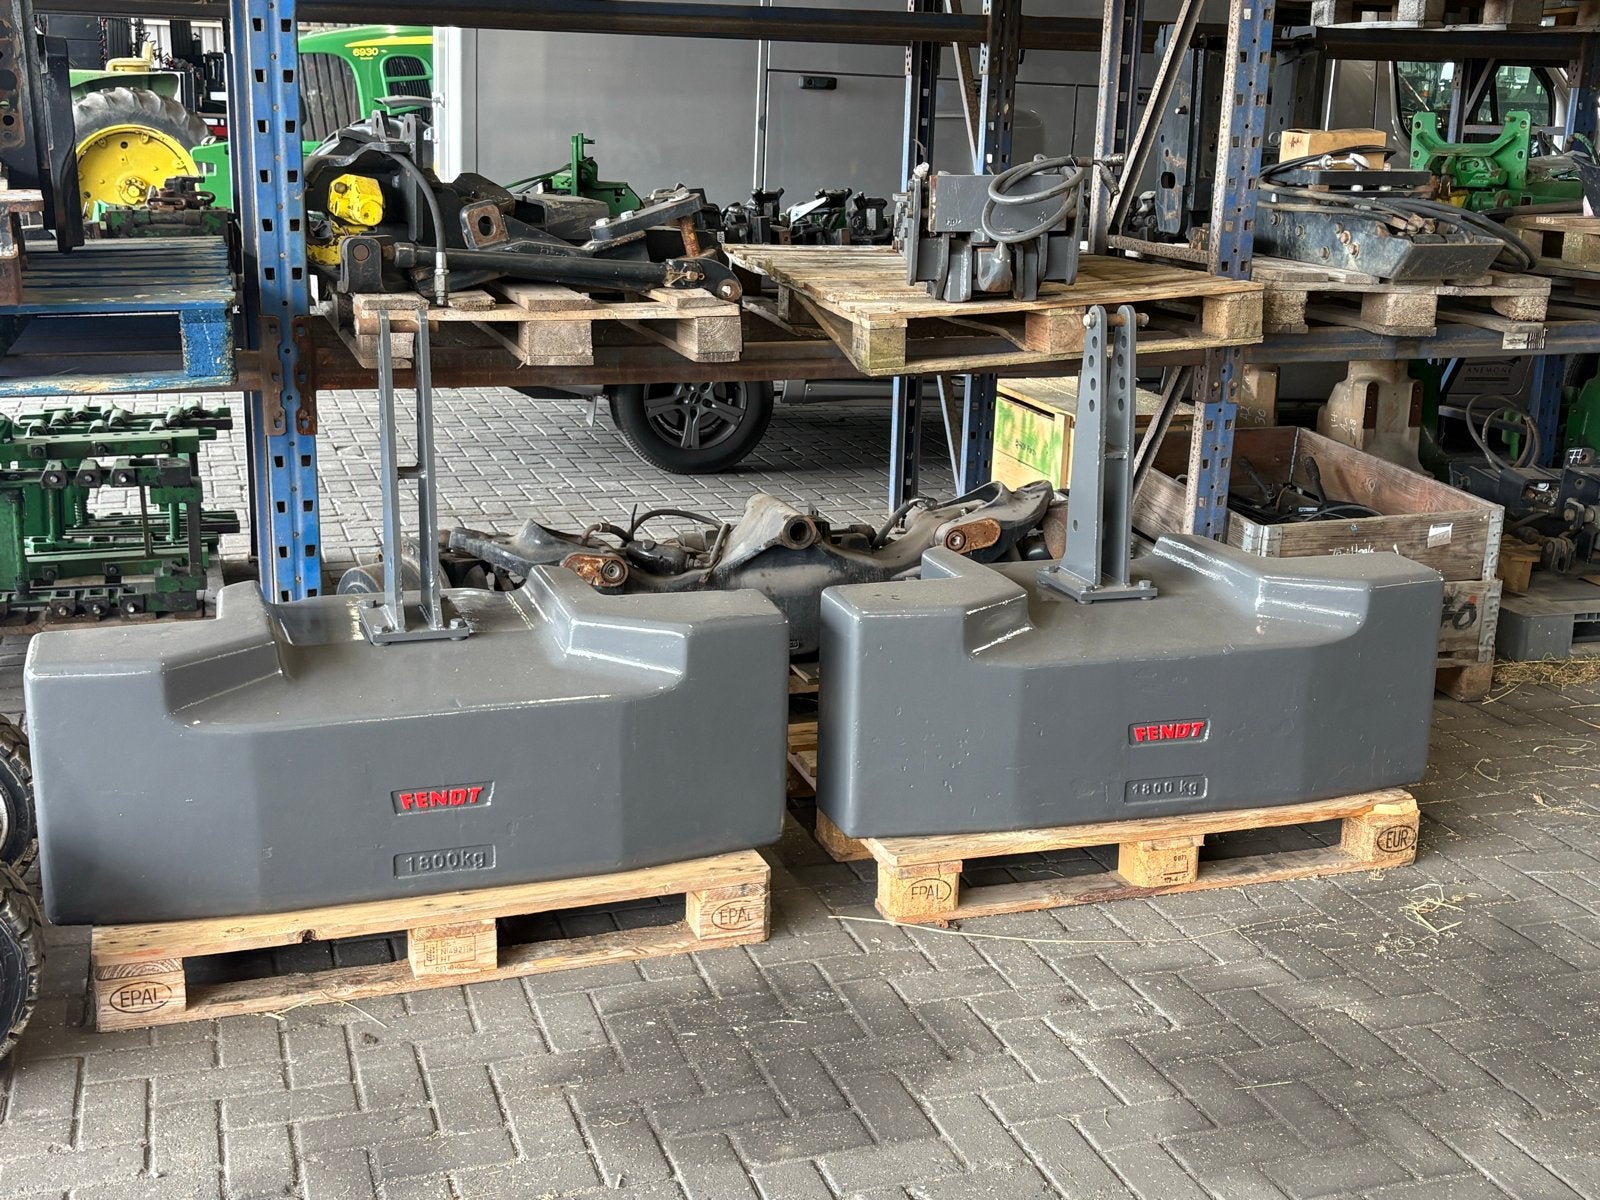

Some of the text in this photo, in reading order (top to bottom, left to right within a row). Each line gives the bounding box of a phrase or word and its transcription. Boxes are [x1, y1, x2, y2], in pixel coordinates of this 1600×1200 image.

[353, 47, 379, 57] 6930
[1133, 721, 1206, 742] FENDT
[399, 785, 485, 811] FENDT
[1131, 779, 1199, 796] 1800 kg
[1386, 828, 1409, 849] EUR
[405, 848, 486, 873] 1800kg
[911, 883, 944, 902] EPAL
[719, 906, 753, 925] EPAL
[120, 987, 164, 1008] EPAL
